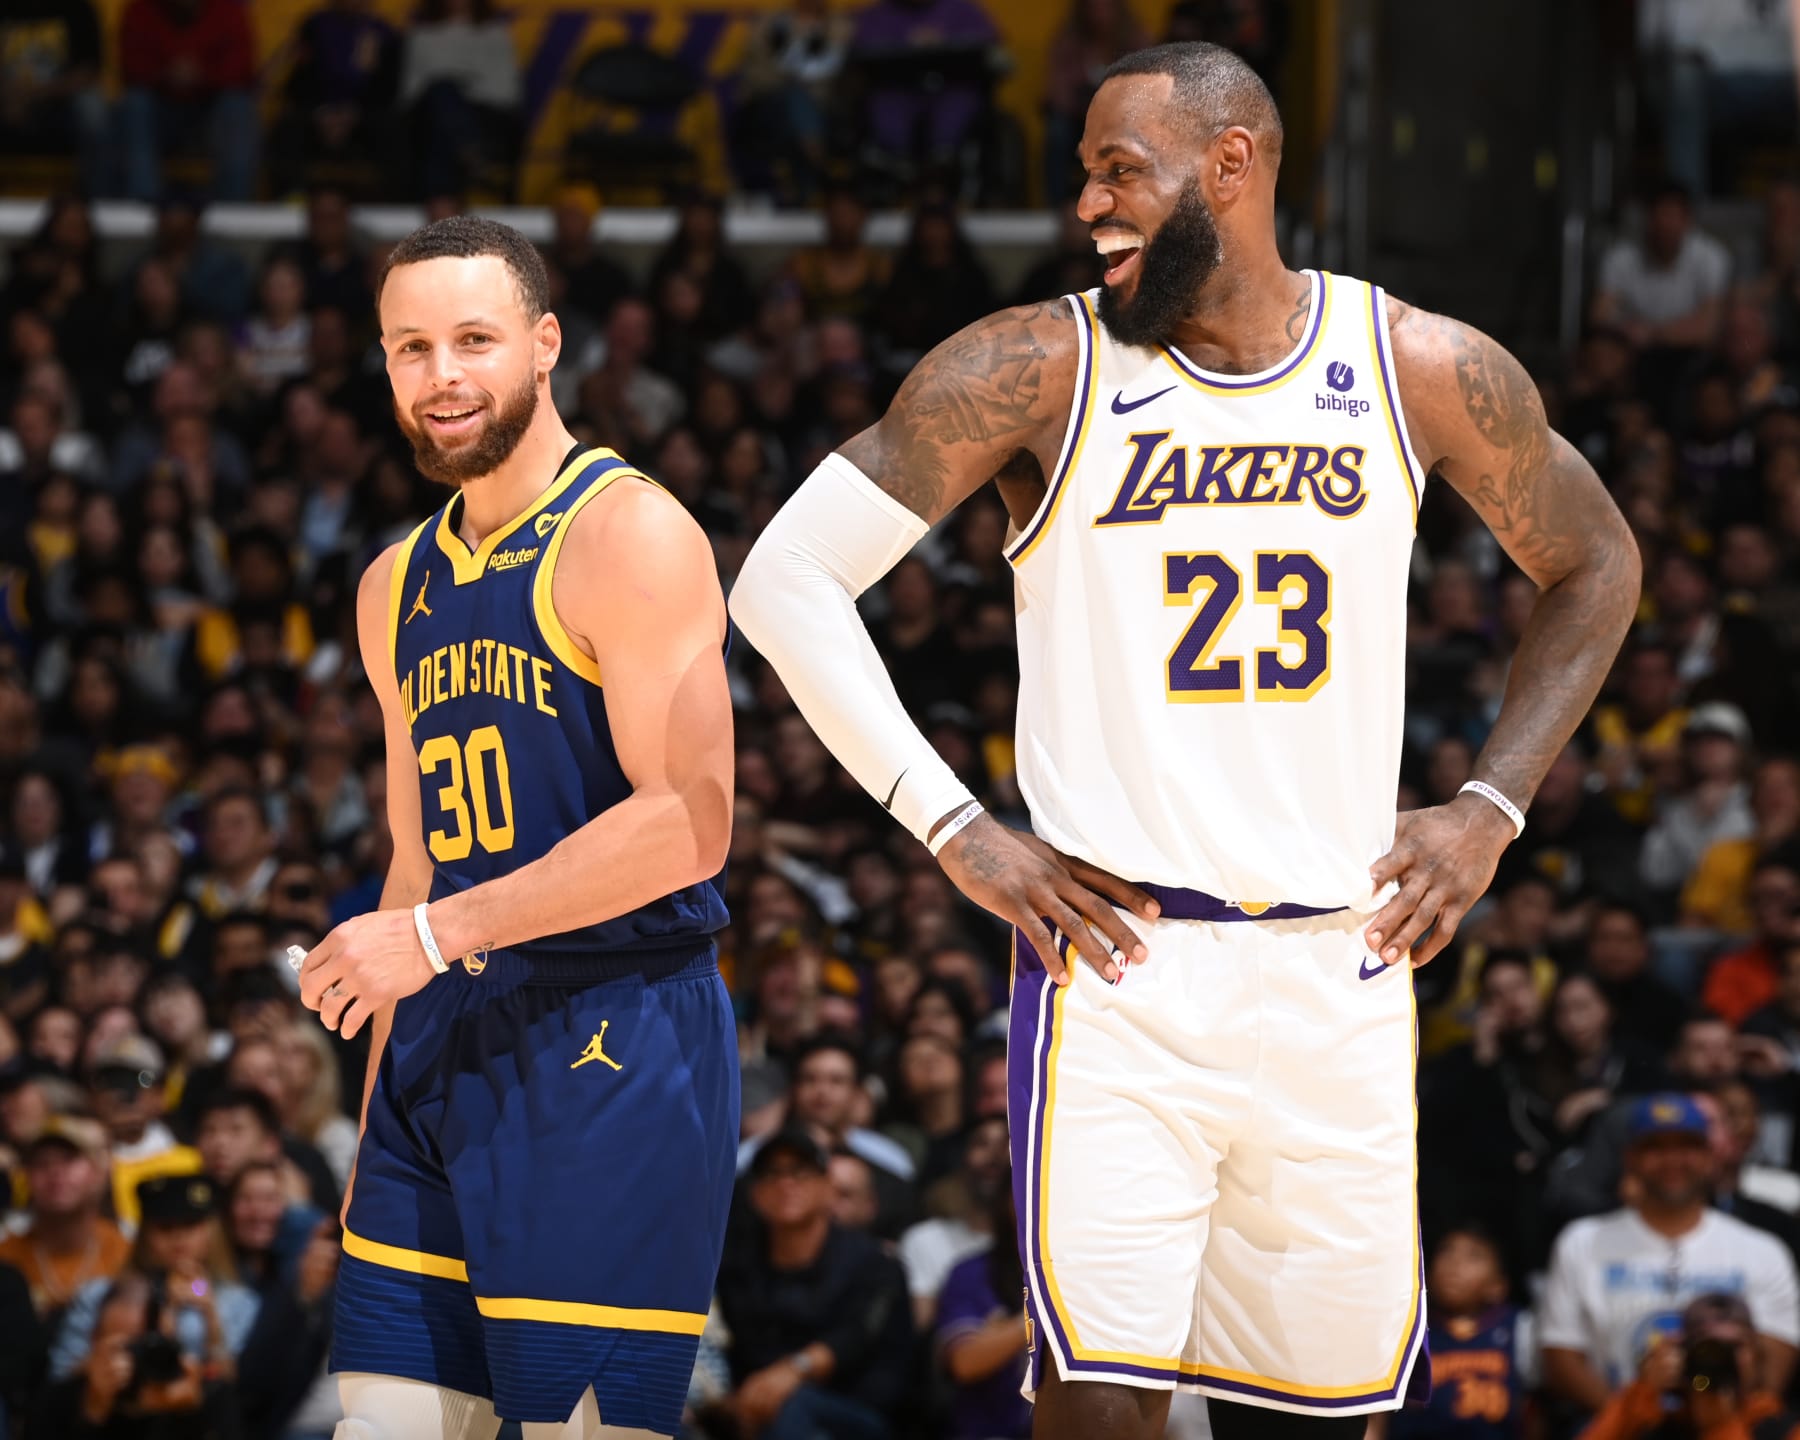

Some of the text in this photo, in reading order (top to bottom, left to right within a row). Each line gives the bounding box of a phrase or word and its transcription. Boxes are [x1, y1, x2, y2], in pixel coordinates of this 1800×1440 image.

[1315, 393, 1370, 417] bibigo
[1090, 428, 1370, 529] LAKERS
[487, 547, 539, 571] Rakuten
[1162, 550, 1332, 704] 23
[401, 638, 558, 737] OLDEN STATE
[418, 725, 514, 863] 30
[1471, 782, 1512, 811] PROMISE
